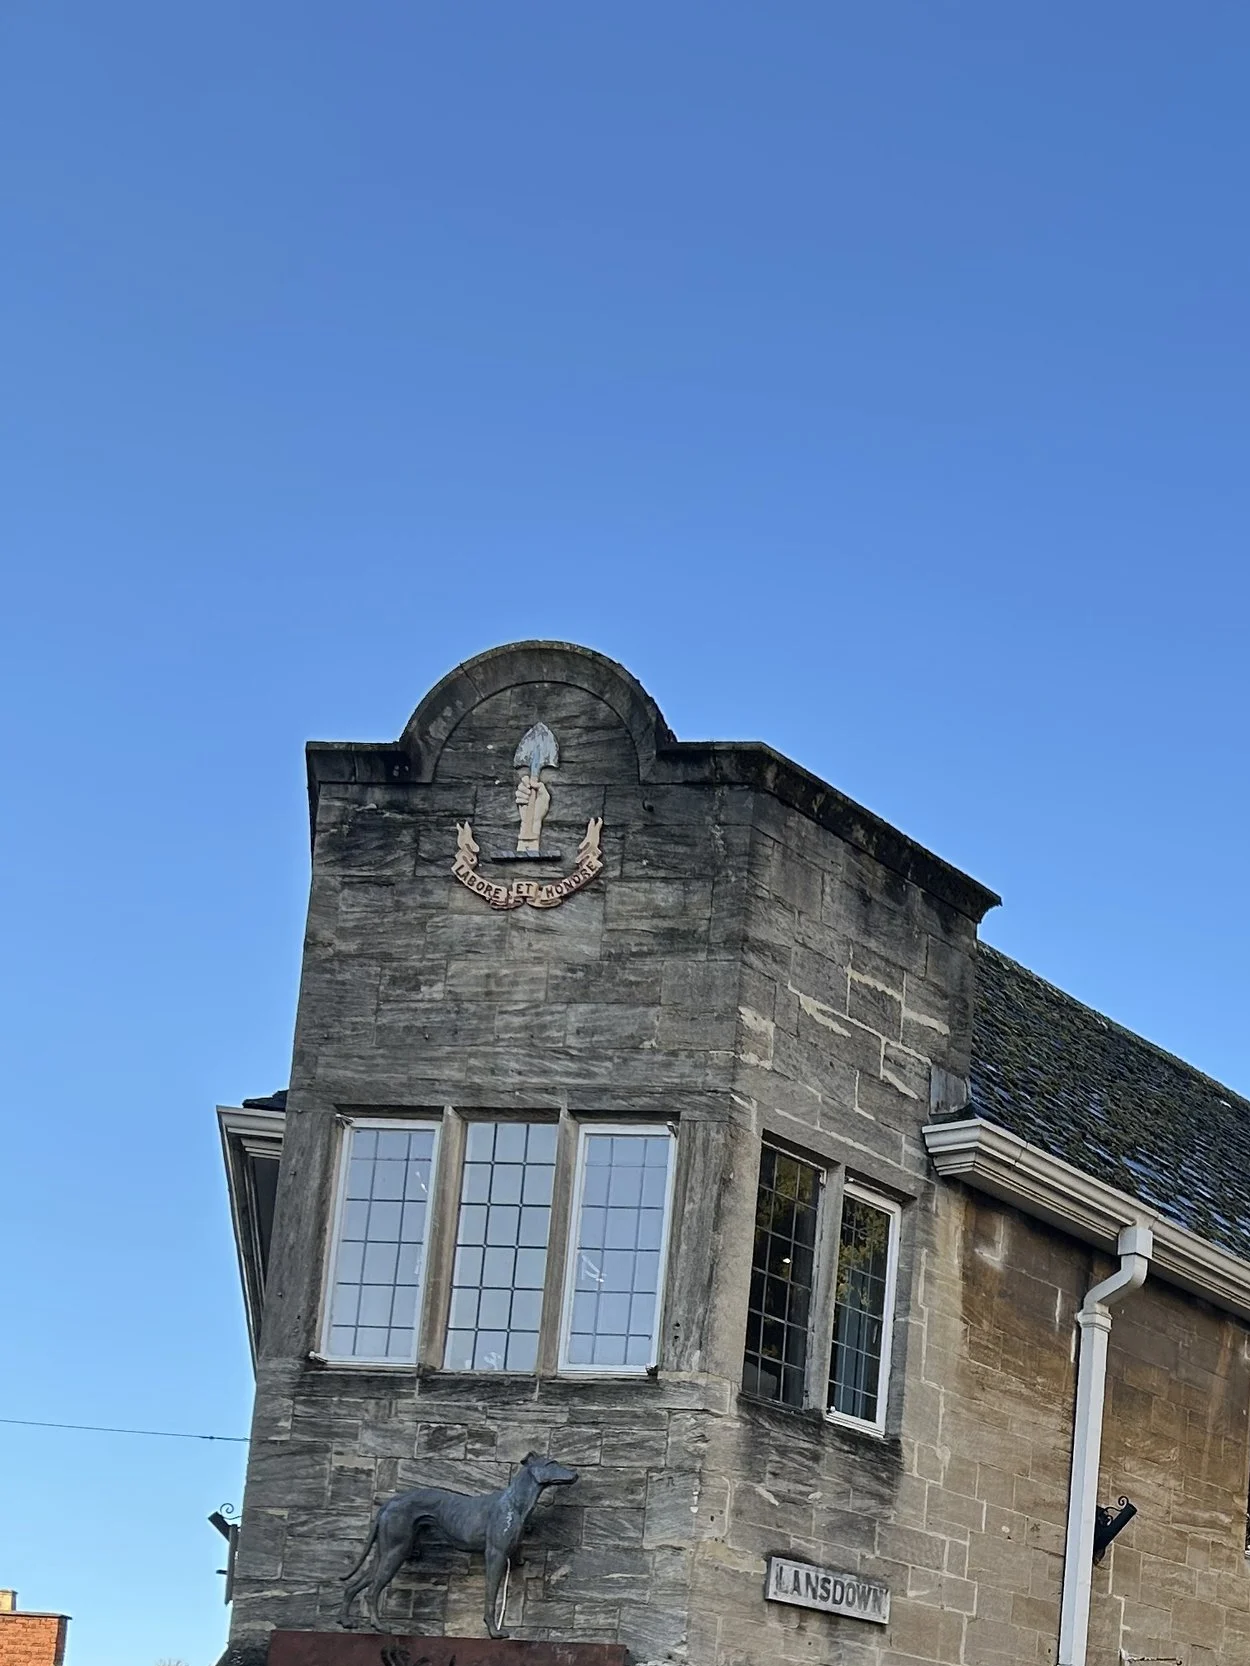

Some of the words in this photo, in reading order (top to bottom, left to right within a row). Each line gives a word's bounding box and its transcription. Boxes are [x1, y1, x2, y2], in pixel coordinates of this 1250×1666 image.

[455, 864, 501, 899] LABORE
[516, 883, 534, 896] ET
[545, 861, 597, 898] HONORE
[775, 1566, 884, 1615] LANSDOWN
